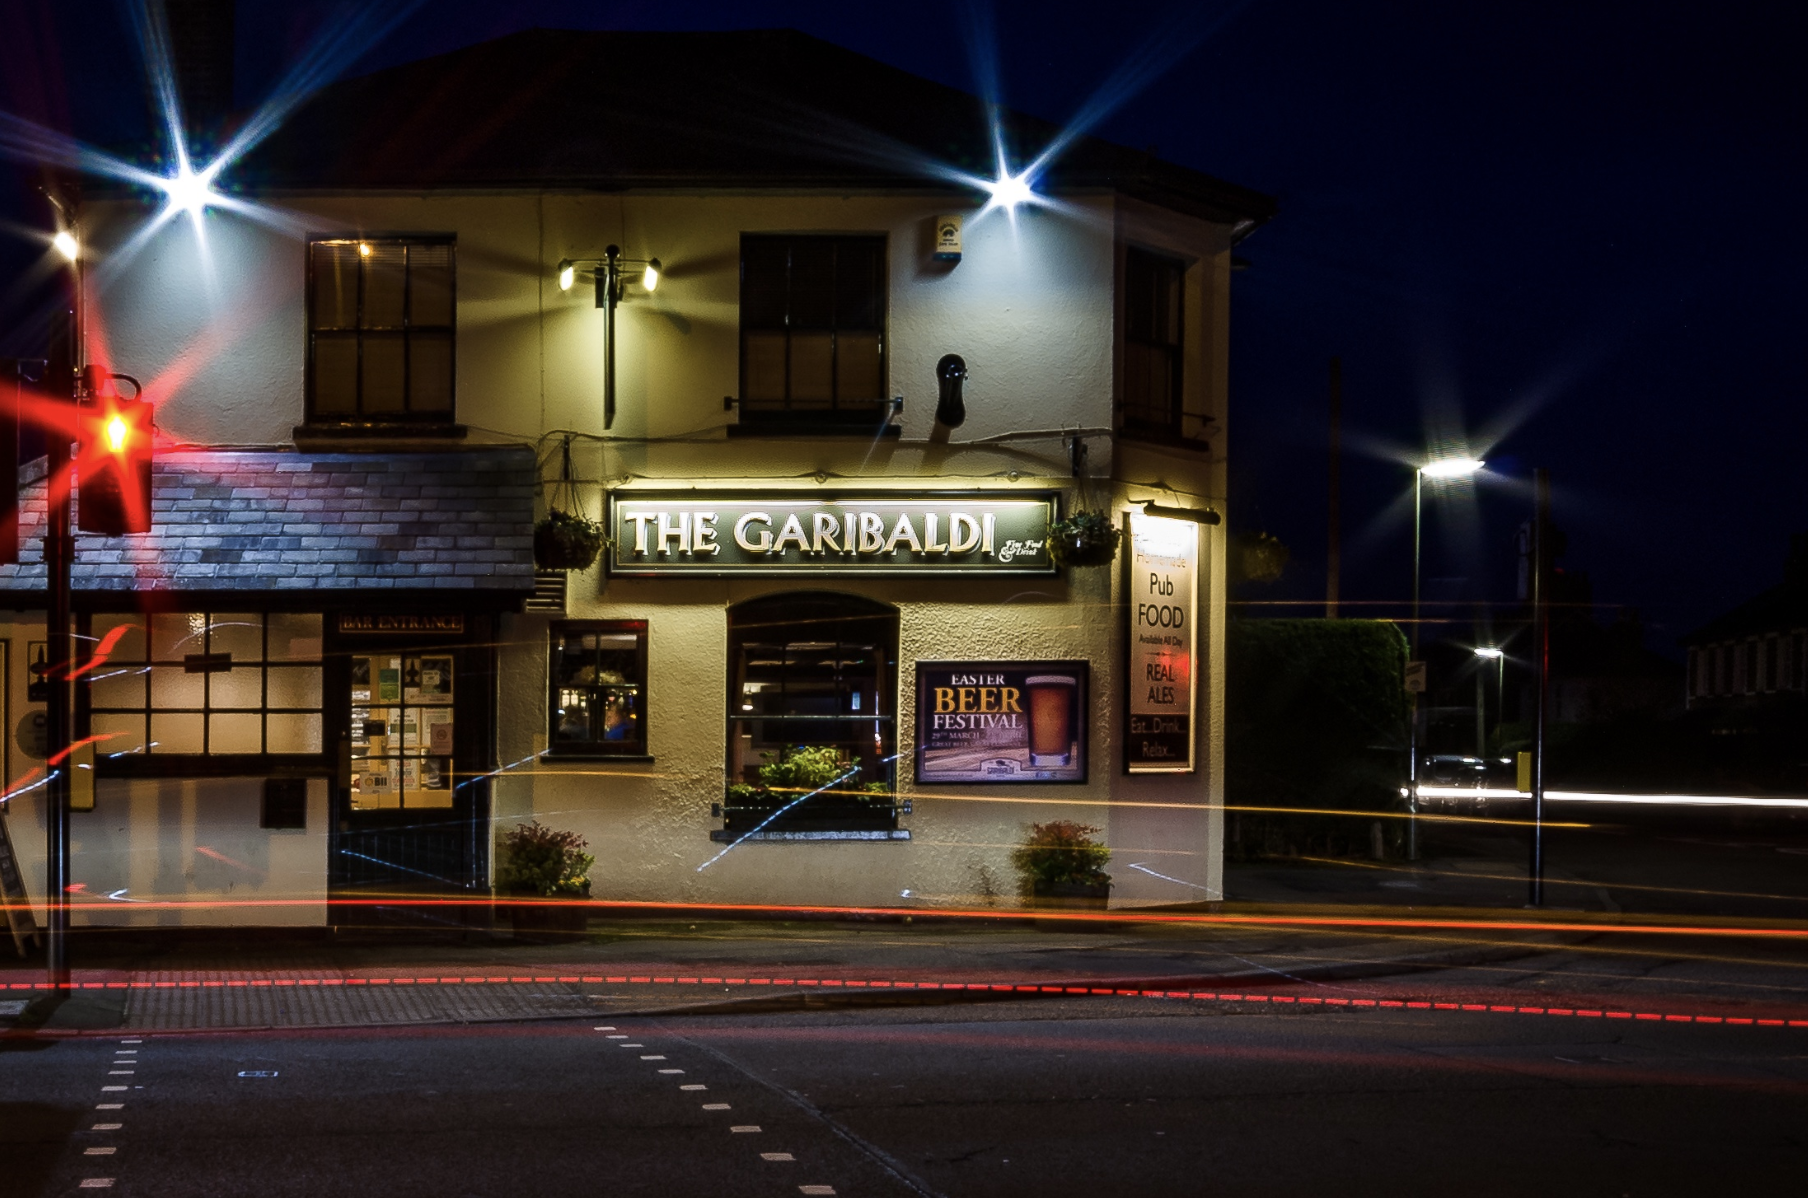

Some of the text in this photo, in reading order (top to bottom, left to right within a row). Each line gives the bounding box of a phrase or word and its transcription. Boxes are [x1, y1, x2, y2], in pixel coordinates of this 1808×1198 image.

[624, 510, 998, 556] THE GARIBALDI
[1149, 572, 1174, 596] Pub
[344, 616, 461, 628] BAR ENTRANCE
[1138, 603, 1184, 629] FOOD
[1172, 635, 1183, 648] Day
[951, 674, 1005, 686] EASTER
[1146, 663, 1175, 682] REAL
[933, 687, 1023, 713] BEER
[1147, 686, 1175, 705] ALES
[933, 713, 1023, 730] FESTIVAL
[949, 731, 980, 740] MARCH
